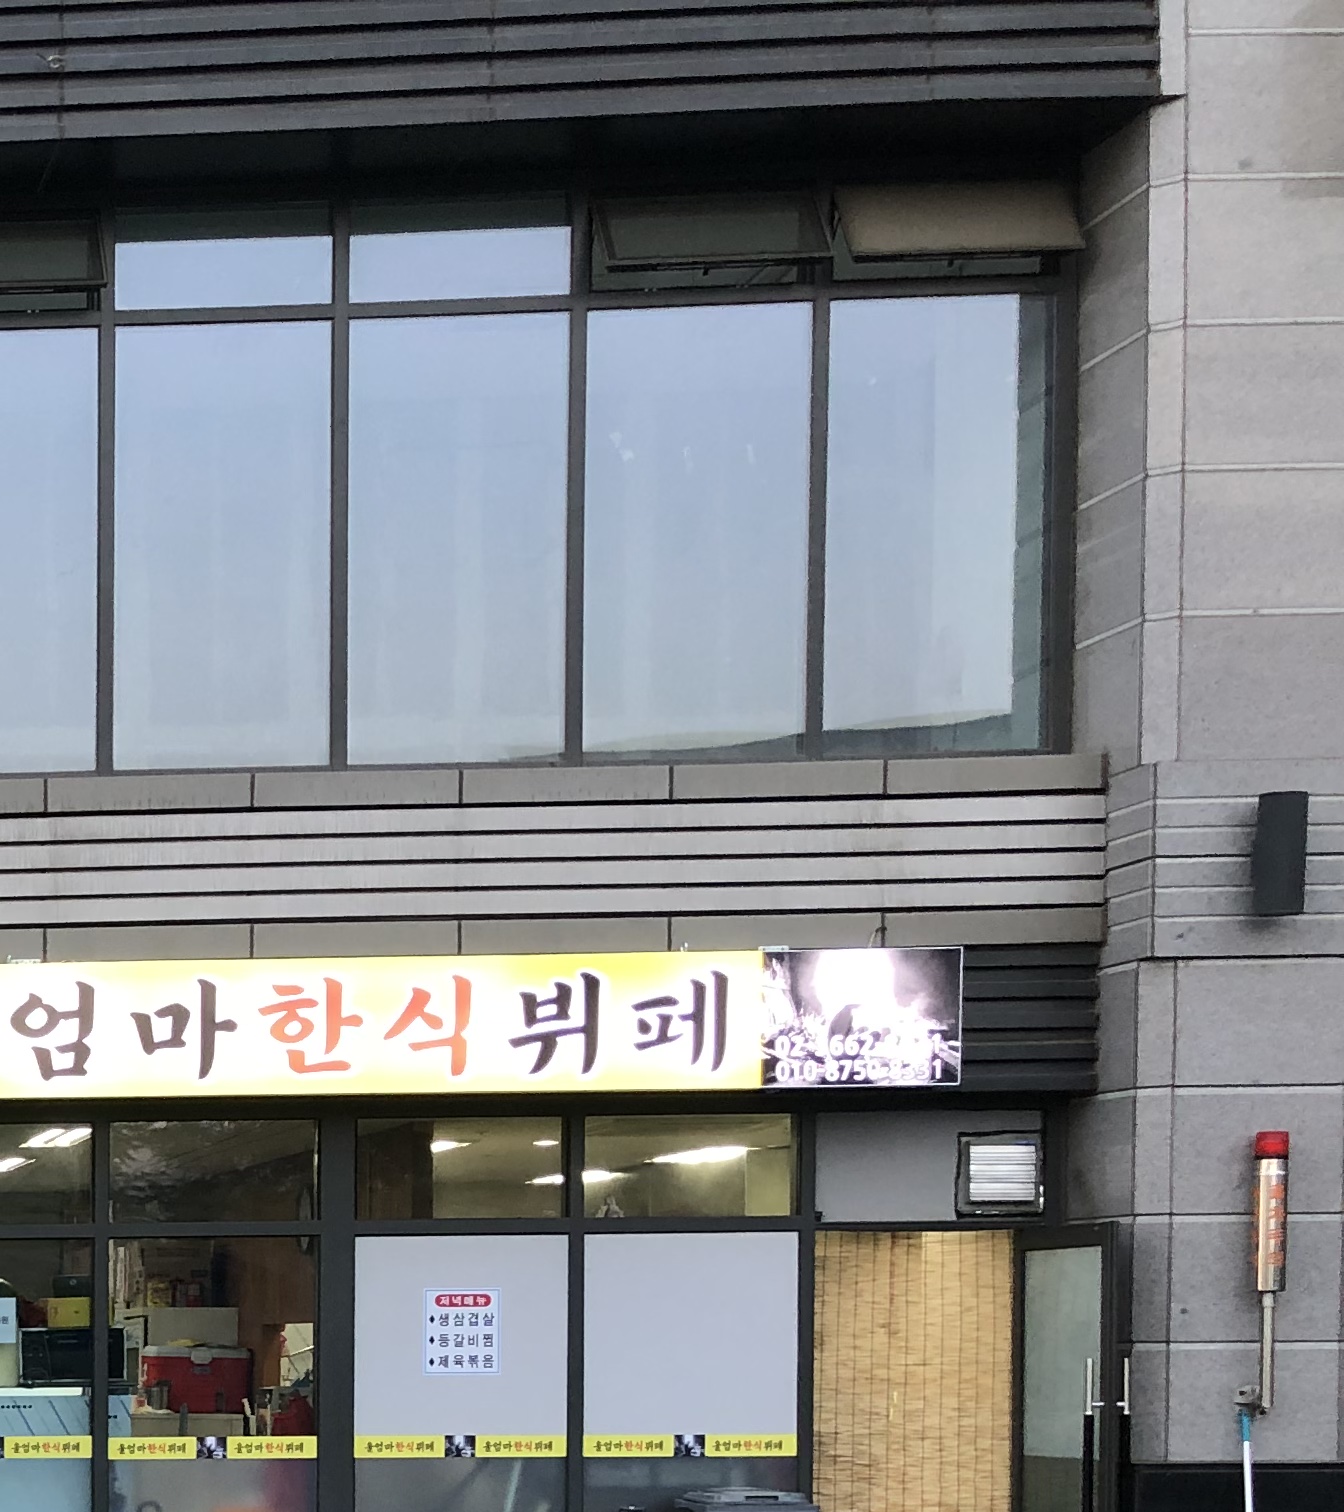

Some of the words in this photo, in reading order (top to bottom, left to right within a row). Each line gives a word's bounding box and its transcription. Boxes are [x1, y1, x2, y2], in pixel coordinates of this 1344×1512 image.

[438, 1312, 495, 1327] 생삼겹살
[438, 1333, 494, 1348] 등갈비찜
[438, 1354, 495, 1369] 제육볶음
